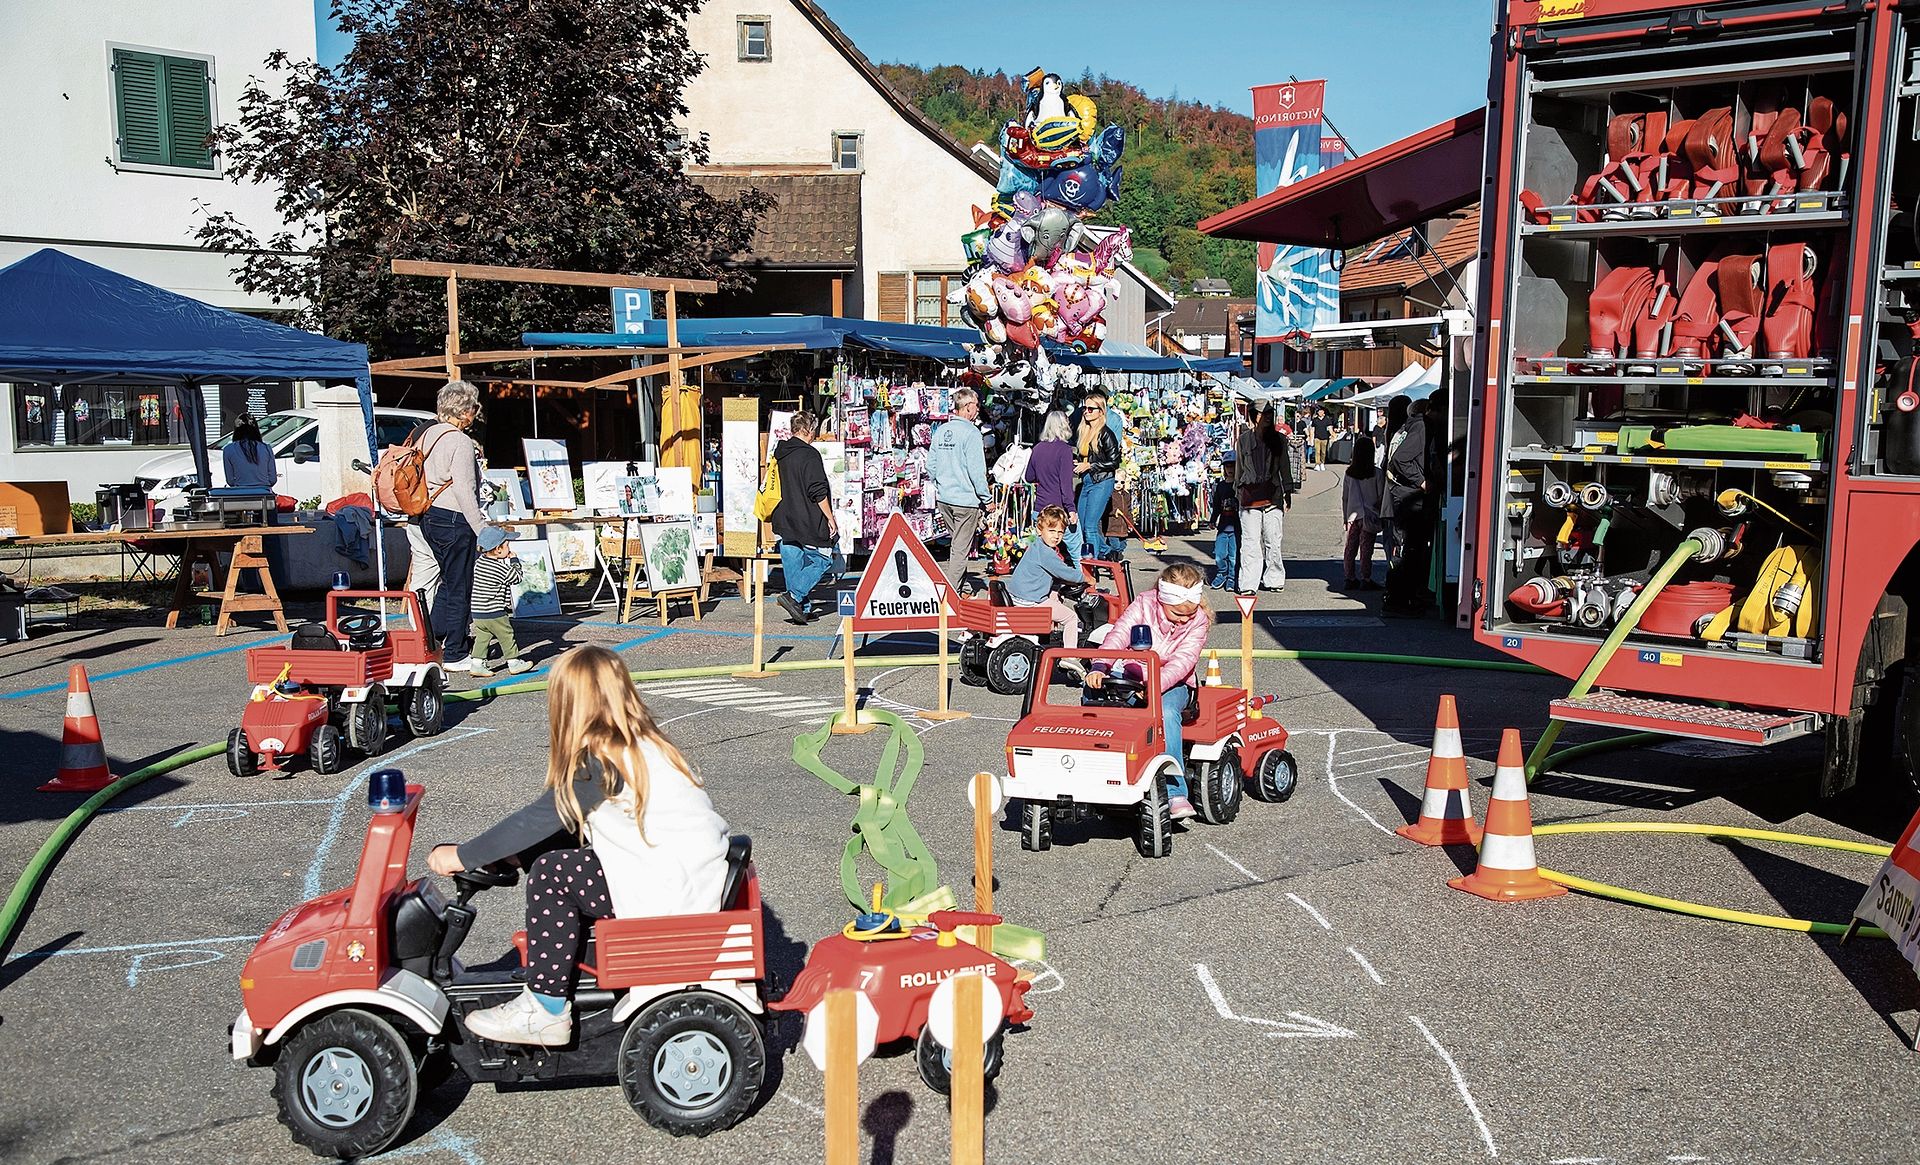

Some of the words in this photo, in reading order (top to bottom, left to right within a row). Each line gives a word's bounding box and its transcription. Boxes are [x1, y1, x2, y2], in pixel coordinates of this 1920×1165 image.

[624, 292, 641, 321] P
[869, 597, 940, 616] Feuerweh
[1506, 638, 1518, 647] 20
[1643, 653, 1656, 662] 40
[1032, 726, 1115, 738] FEUERWEHR
[1248, 730, 1268, 742] ROLLY
[1268, 726, 1281, 737] FIRE
[859, 971, 874, 990] 7
